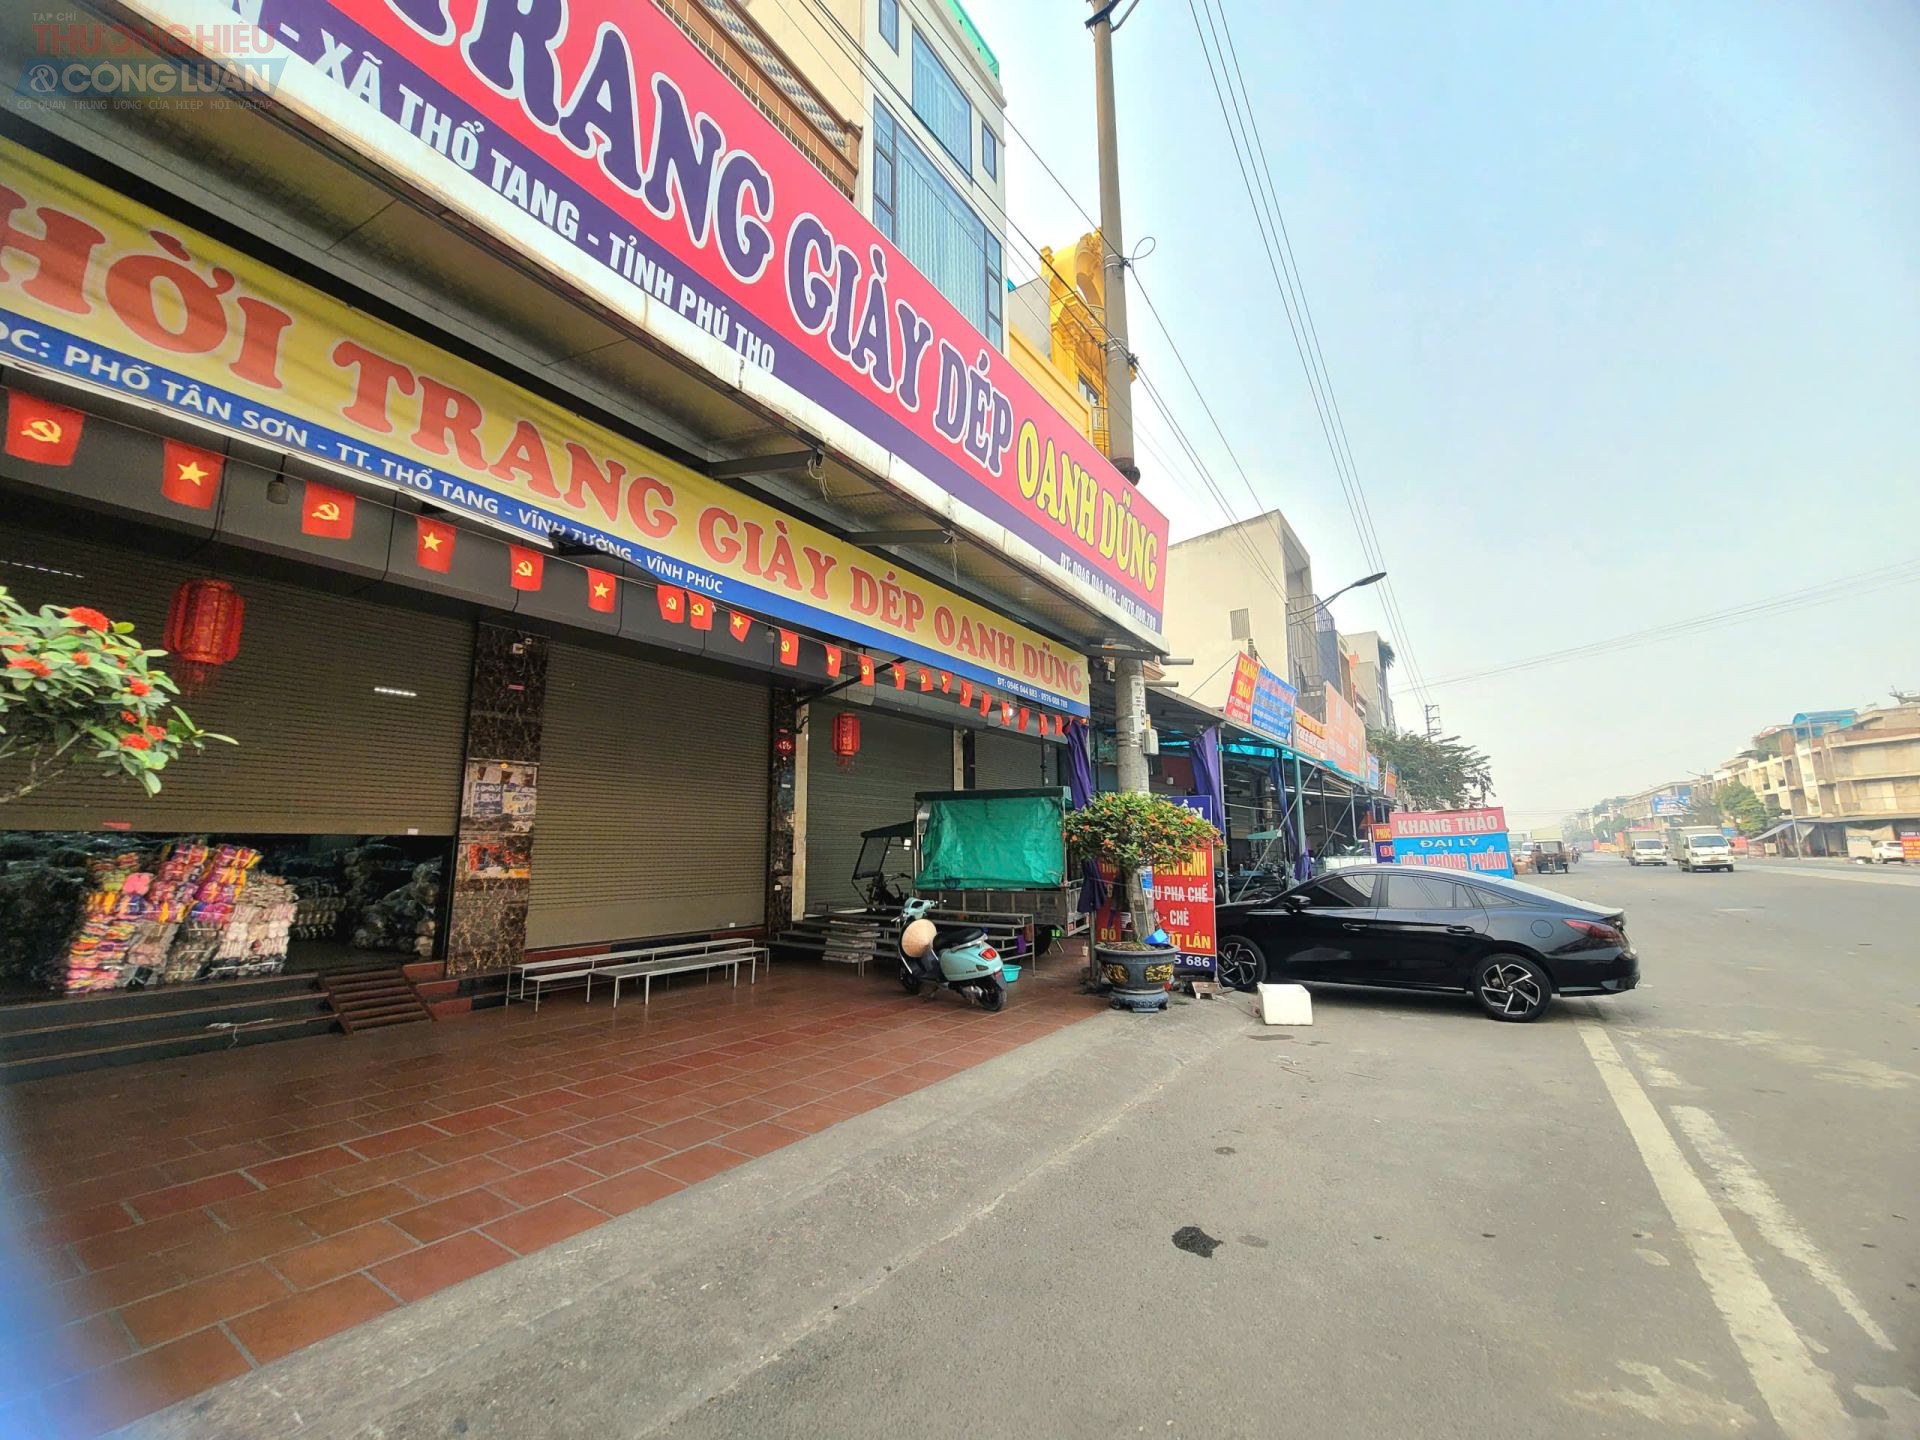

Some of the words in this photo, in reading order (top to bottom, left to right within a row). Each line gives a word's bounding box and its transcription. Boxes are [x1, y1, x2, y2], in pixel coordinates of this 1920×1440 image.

[312, 28, 384, 112] XÃ
[398, 83, 487, 173] THỔ
[490, 149, 581, 238] TANG
[608, 230, 677, 309] TỈNH
[678, 286, 730, 349] PHÚ
[384, 0, 774, 285] RANG
[784, 212, 934, 414] GIÀY
[932, 336, 1015, 478] DÉP
[1015, 418, 1099, 548] OANH
[1100, 483, 1159, 593] DŨNG
[63, 343, 151, 390] PHỐ
[160, 376, 232, 421] TÂN
[240, 409, 309, 448] SƠN
[336, 442, 373, 471] TT.
[381, 457, 433, 492] THỔ
[441, 480, 499, 516] TANG
[519, 506, 566, 537] VĨNH
[571, 527, 632, 561] TƯỜNG
[646, 552, 684, 582] VĨNH
[686, 568, 724, 594] PHÚC
[331, 340, 679, 540] TRANG
[699, 505, 838, 600] GIÀY
[849, 565, 925, 635] DÉP
[934, 605, 1015, 673] OANH
[1022, 642, 1084, 696] DŨNG
[1397, 818, 1452, 834] KHANG
[1456, 813, 1498, 832] THẢO
[1460, 835, 1479, 847] LÝ
[1426, 849, 1469, 871] PHÒNG
[1166, 886, 1185, 902] PHA
[1185, 955, 1211, 968] 686
